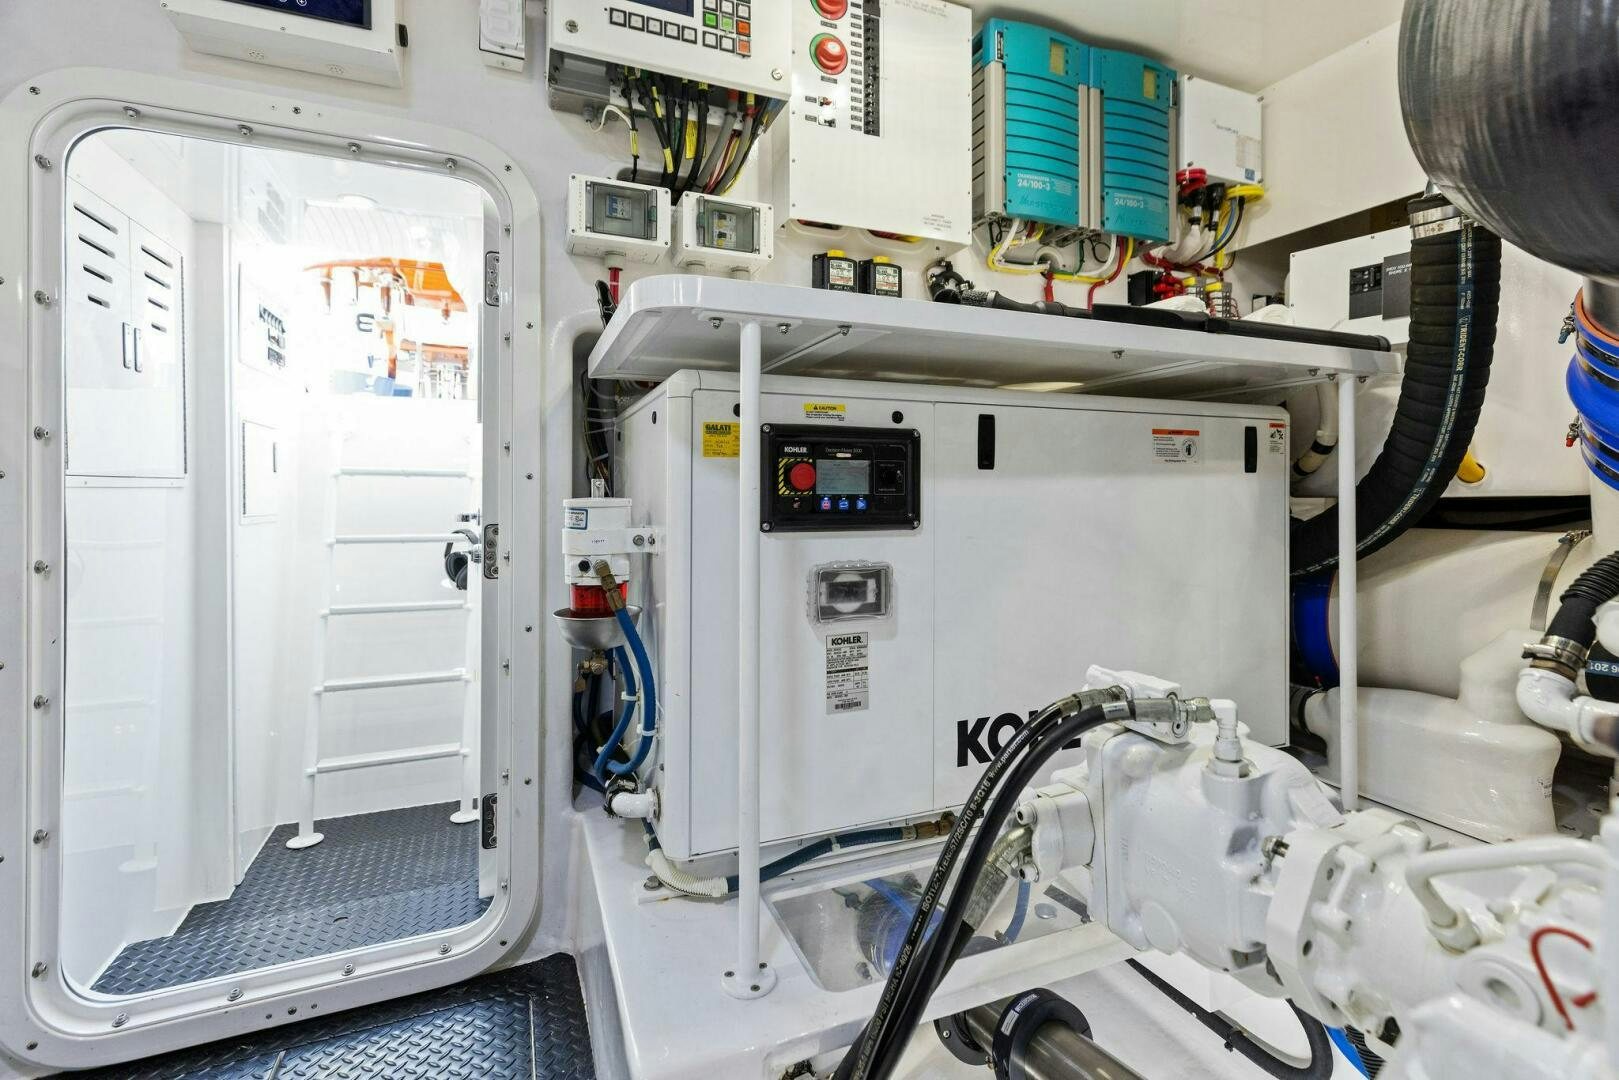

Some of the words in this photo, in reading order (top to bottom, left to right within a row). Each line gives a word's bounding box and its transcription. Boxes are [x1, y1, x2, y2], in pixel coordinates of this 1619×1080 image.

[1017, 179, 1050, 191] 24/100-3
[1114, 198, 1144, 208] 24/100-3
[832, 636, 862, 646] KOHLER
[988, 729, 1029, 778] www.parker.com
